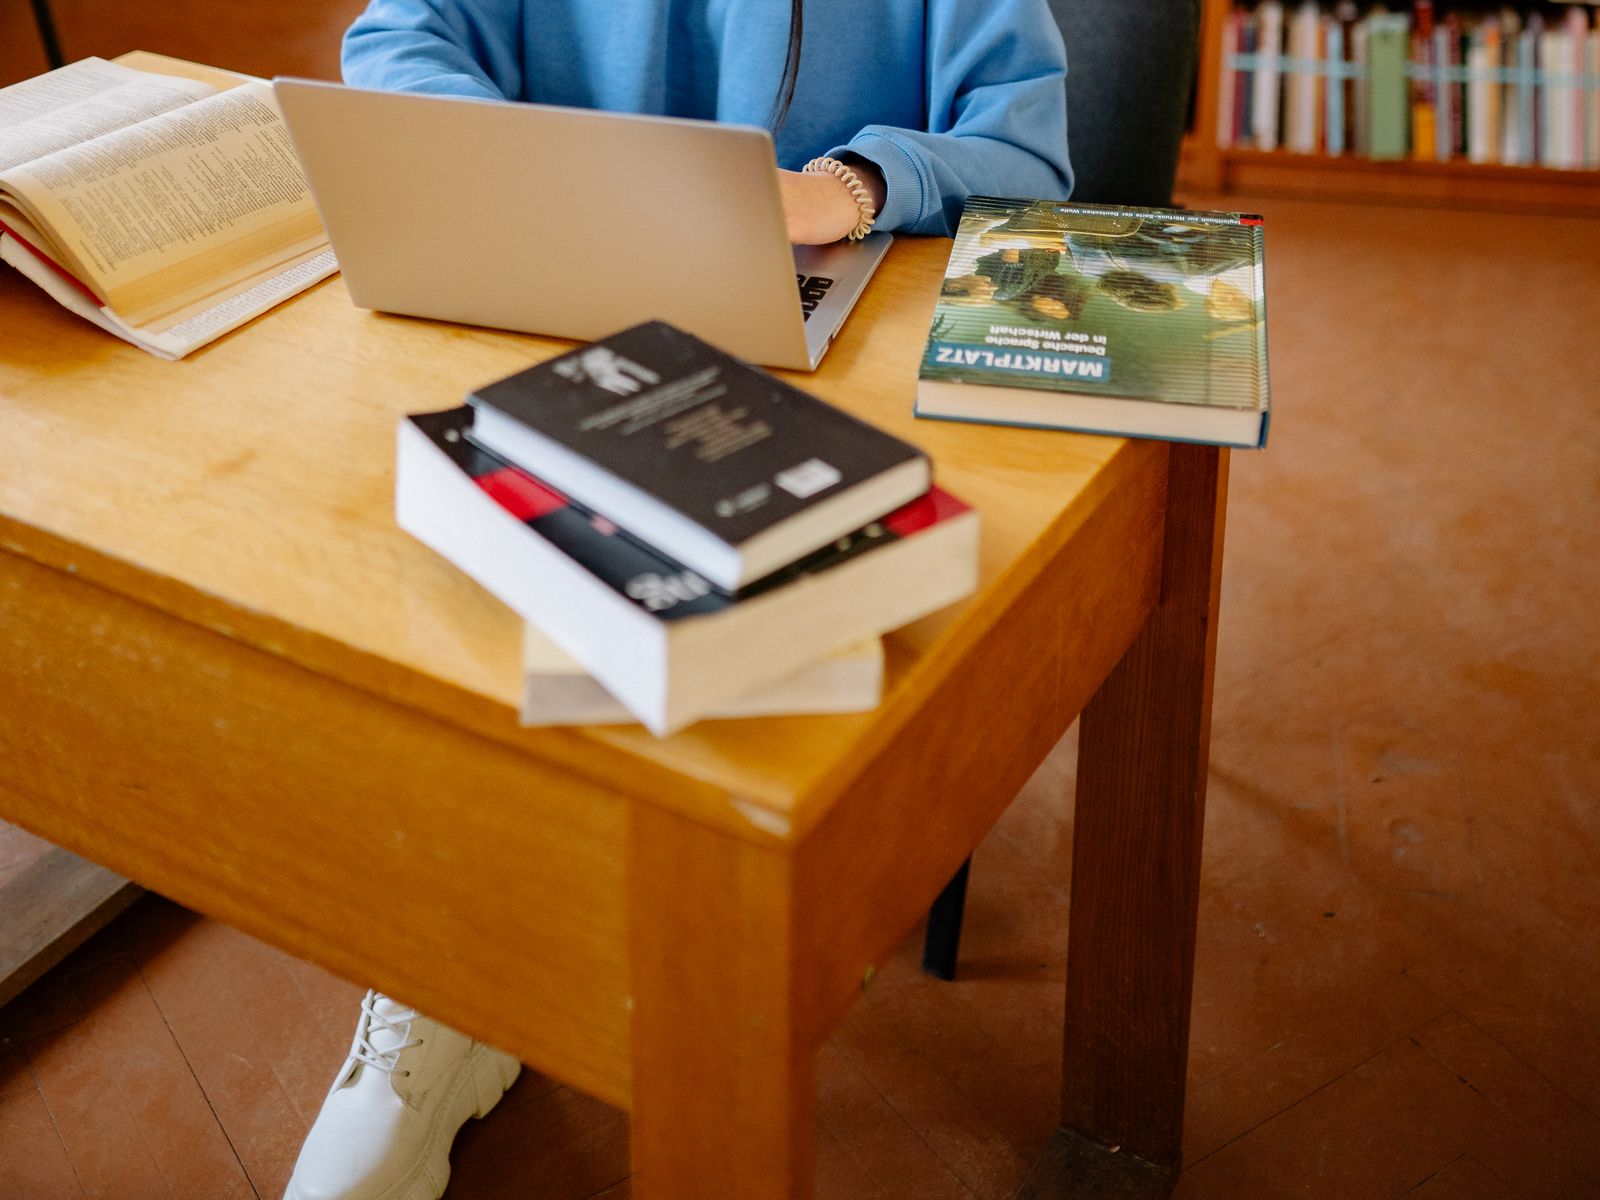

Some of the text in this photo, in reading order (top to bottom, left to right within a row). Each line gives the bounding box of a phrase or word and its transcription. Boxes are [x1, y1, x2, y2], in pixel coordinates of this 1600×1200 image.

[1060, 207, 1080, 215] Welle
[1082, 209, 1119, 217] Deutschen
[989, 325, 1062, 341] Wirtschaft
[1064, 331, 1090, 343] der
[984, 335, 1106, 357] Deutsche Sprache
[935, 347, 1104, 378] MARKTPLATZ
